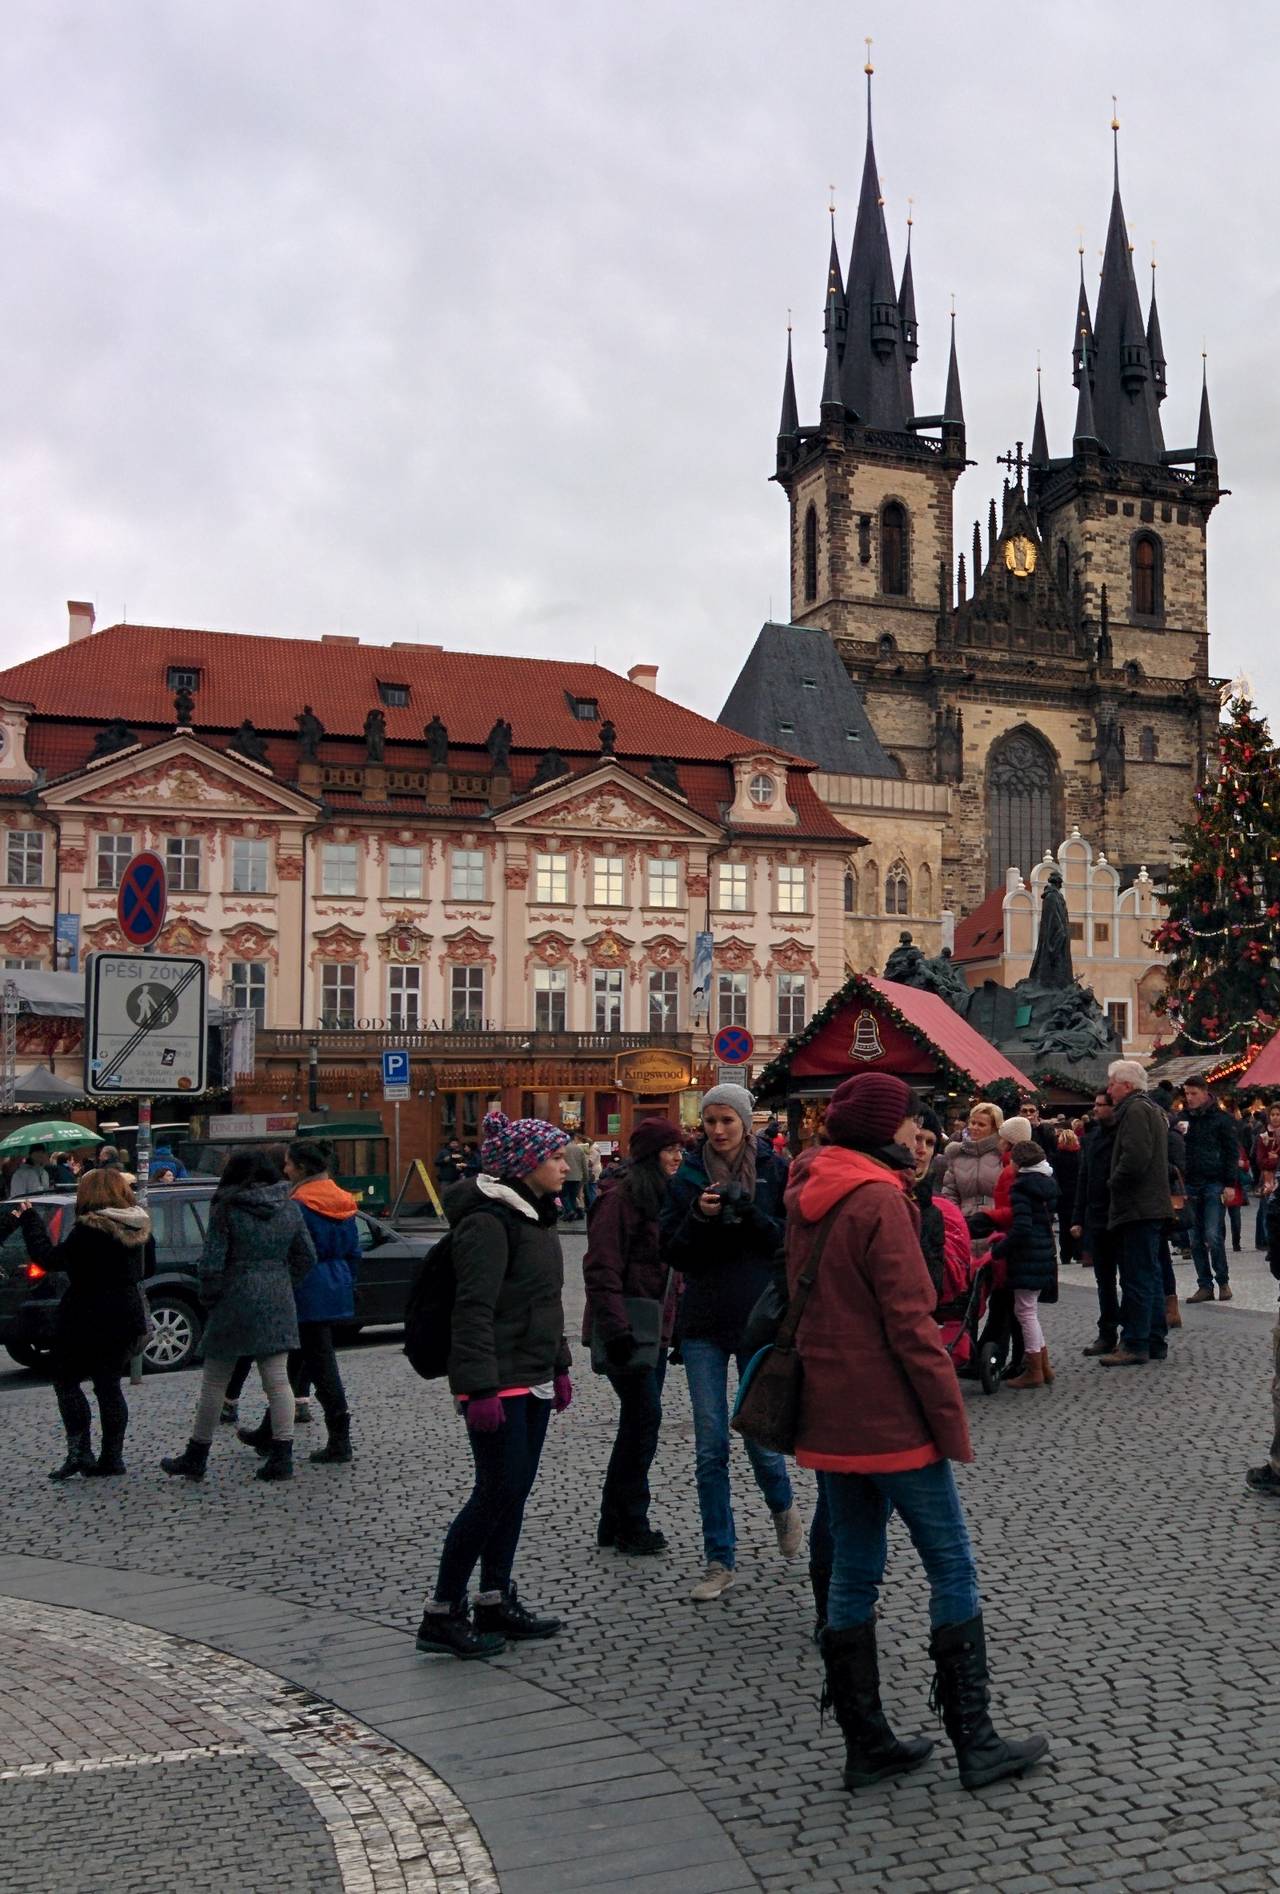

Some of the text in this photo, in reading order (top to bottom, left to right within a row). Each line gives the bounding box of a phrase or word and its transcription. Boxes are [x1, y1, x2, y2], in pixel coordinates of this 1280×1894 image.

[104, 961, 197, 980] PĚŠÍ ZÓN
[388, 1055, 404, 1075] P
[624, 1067, 684, 1083] Kingswood
